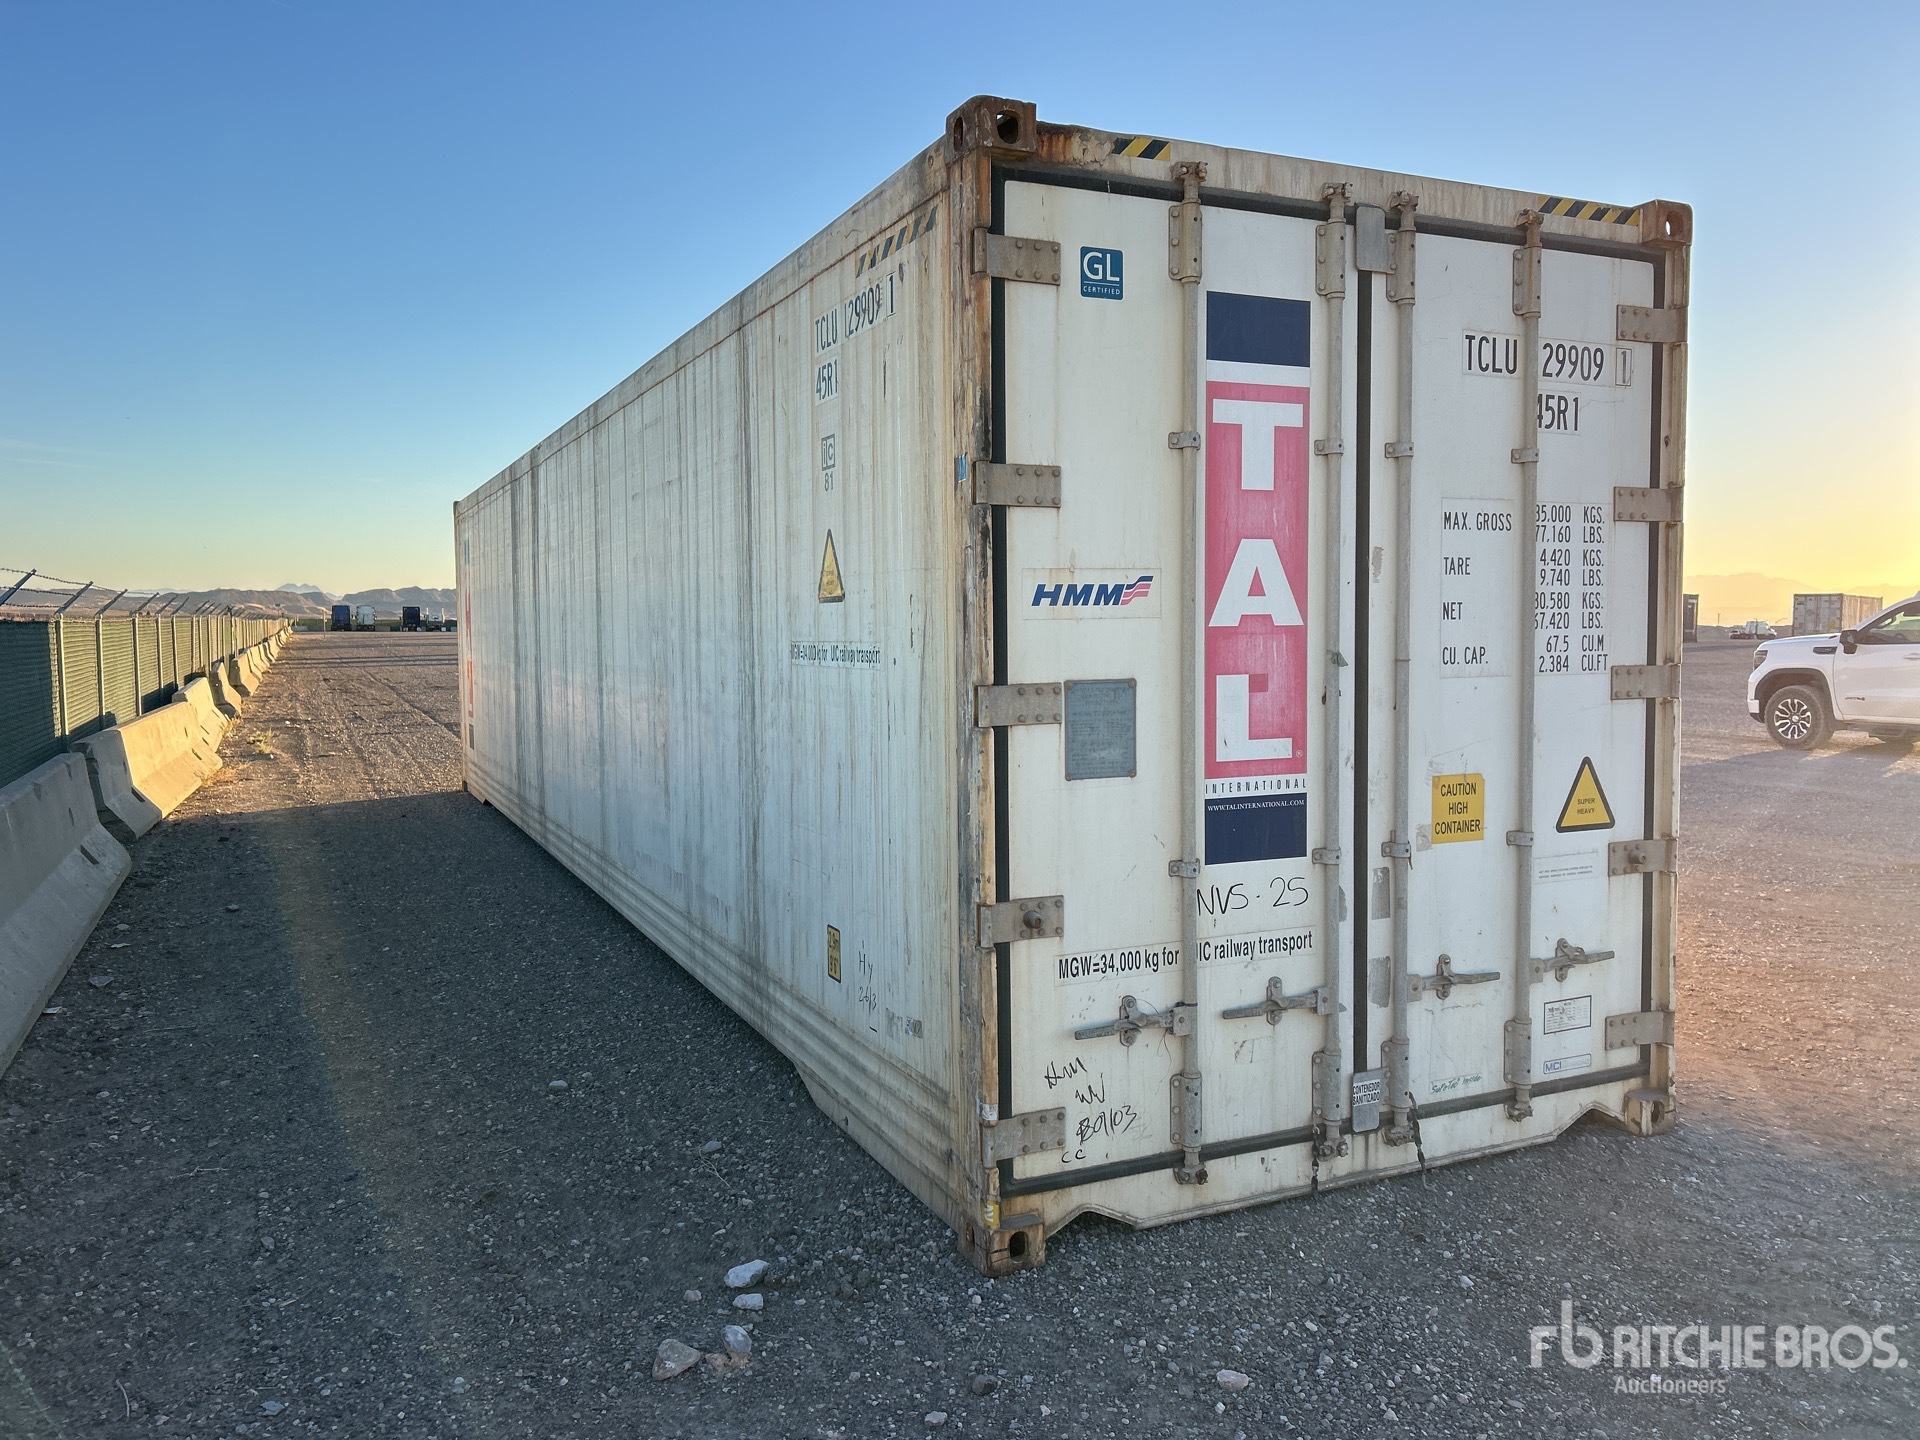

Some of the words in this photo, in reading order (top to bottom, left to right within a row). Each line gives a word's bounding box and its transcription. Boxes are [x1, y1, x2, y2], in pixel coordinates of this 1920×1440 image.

[1083, 251, 1120, 281] GL
[1083, 286, 1121, 295] CERTIFIED
[815, 308, 838, 353] TCLU
[1465, 334, 1518, 375] TCLU
[815, 358, 838, 400] 45R1
[1443, 512, 1472, 531] MAX.
[1476, 513, 1512, 532] GROSS
[1583, 506, 1605, 524] KGS.
[1583, 526, 1604, 544] LBS.
[1444, 557, 1471, 575] TARE
[1540, 548, 1571, 567] 4,420
[1582, 549, 1604, 567] KGS.
[1209, 398, 1304, 762] TAL
[1540, 568, 1570, 587] 9,740
[1582, 569, 1604, 586] LBS.
[1031, 583, 1126, 606] HMM
[1442, 602, 1463, 620] NET
[1582, 592, 1604, 609] KGS.
[1581, 612, 1603, 629] LBS.
[1442, 647, 1460, 665] CU.
[1464, 646, 1489, 665] CAP.
[1546, 635, 1569, 653] 67.5
[1581, 634, 1604, 652] CU.M
[1538, 655, 1569, 673] 2,384
[1581, 654, 1608, 672] CU.FT
[1205, 778, 1307, 794] INTERNATIONAL
[1440, 782, 1477, 797] CAUTION
[1207, 800, 1305, 812] WWW.TALINTERNATIONAL.COM
[1448, 801, 1469, 816] HIGH
[1576, 807, 1595, 815] HEAVY
[1434, 819, 1481, 835] CONTAINER
[1269, 876, 1309, 908] 25
[1058, 950, 1142, 979] MGW=34,000
[1144, 948, 1159, 973] kg
[1162, 946, 1180, 966] for
[1196, 941, 1211, 961] IC
[1214, 938, 1256, 962] railway
[1258, 930, 1313, 957] transport
[1545, 1060, 1562, 1072] MCI
[1353, 1081, 1380, 1095] CONTENEDOR
[1353, 1091, 1380, 1106] SANITIZADO
